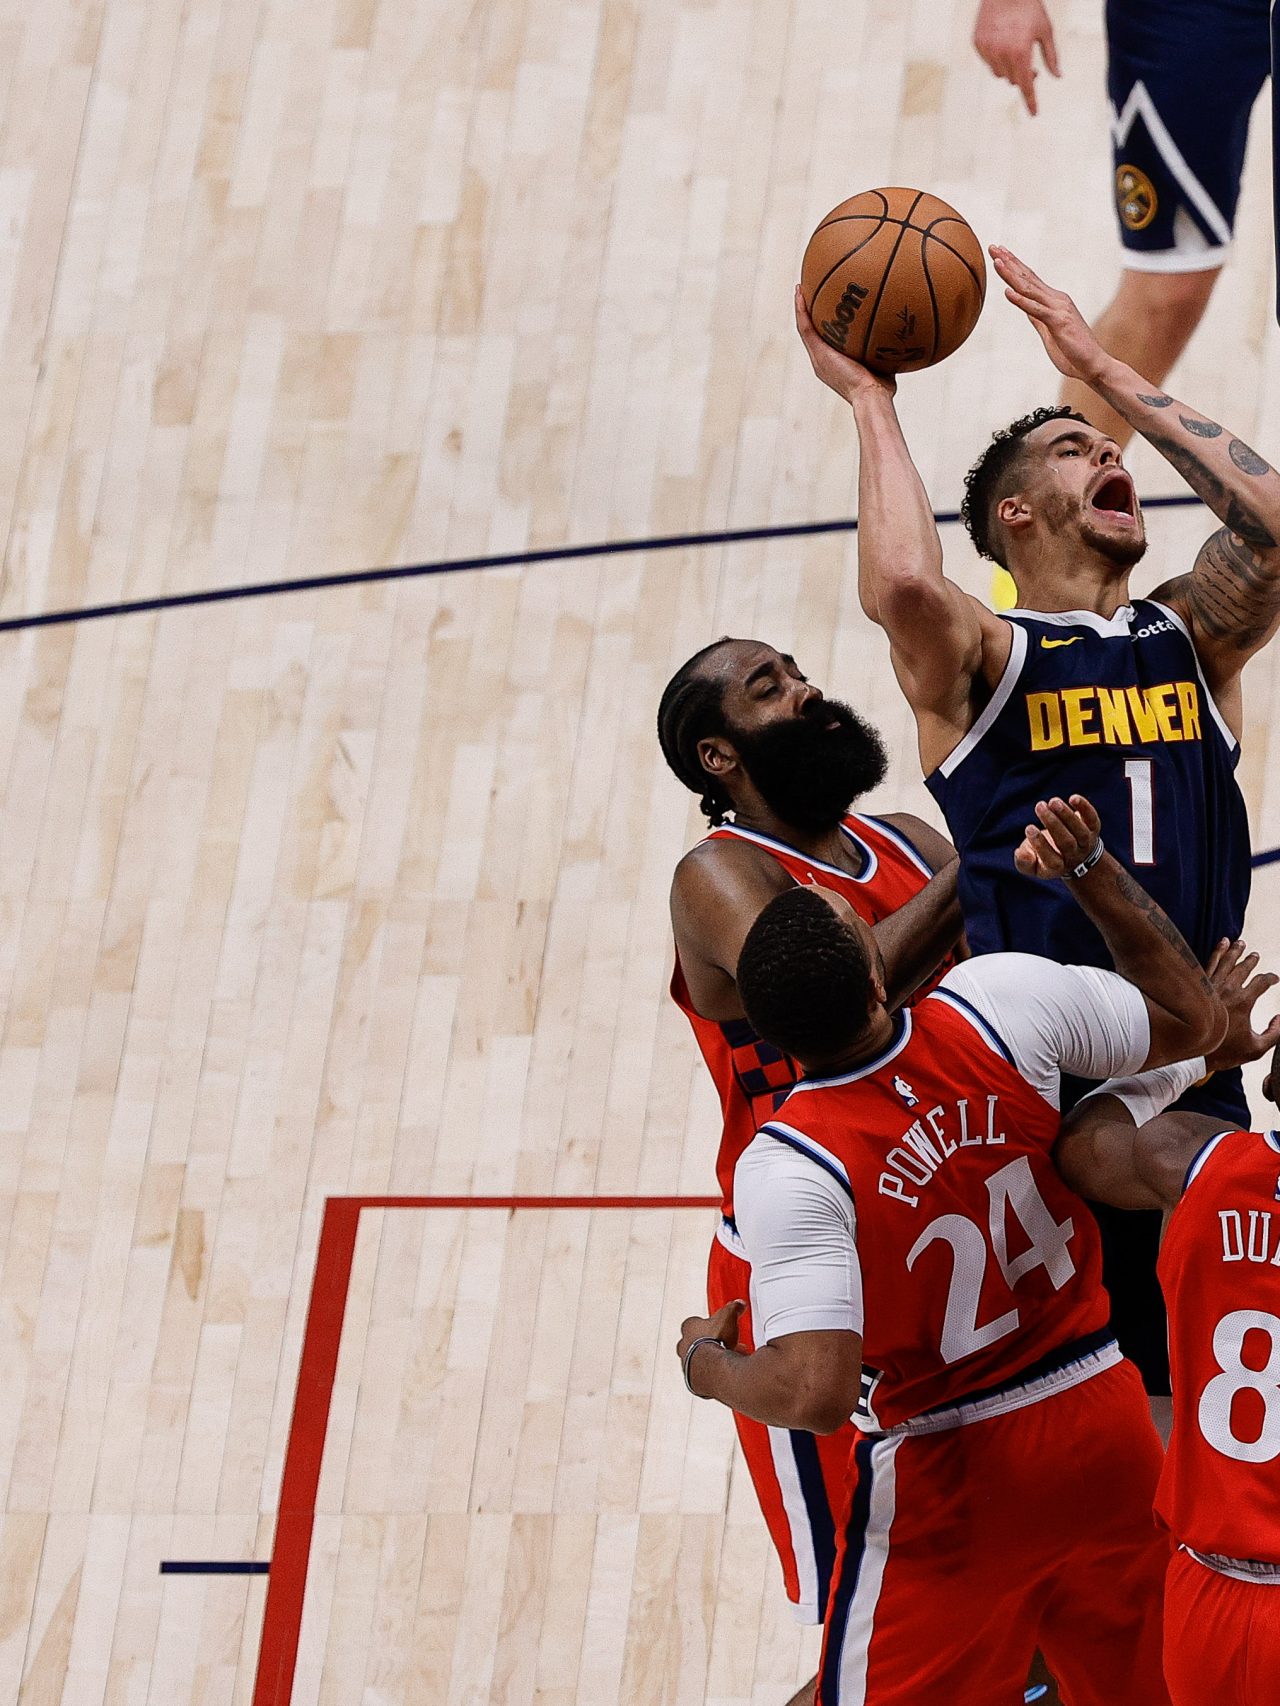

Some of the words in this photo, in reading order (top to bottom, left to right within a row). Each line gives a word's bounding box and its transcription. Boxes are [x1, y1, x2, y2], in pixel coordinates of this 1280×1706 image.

[1025, 681, 1203, 752] DENVER
[1123, 757, 1156, 867] 1
[877, 1095, 1006, 1208] POWELL
[905, 1155, 1075, 1365] 24
